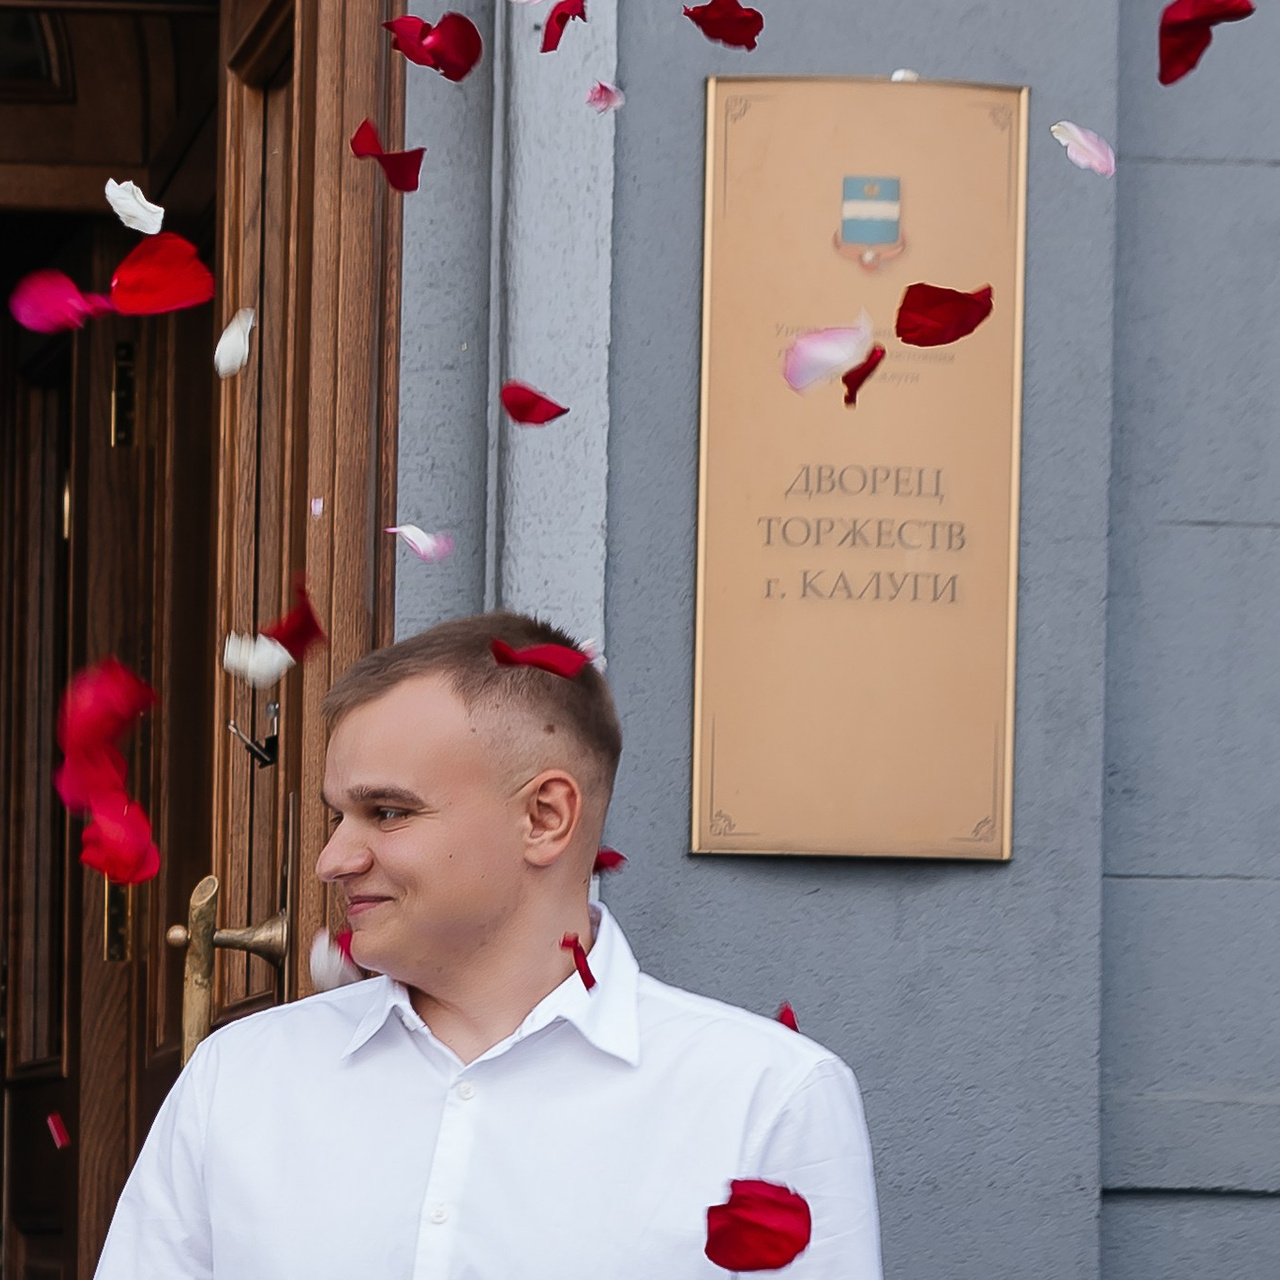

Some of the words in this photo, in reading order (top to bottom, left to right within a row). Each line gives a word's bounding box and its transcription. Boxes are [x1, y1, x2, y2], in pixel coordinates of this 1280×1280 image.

[784, 464, 945, 505] ДВОРЕЦ
[757, 516, 967, 551] ТОРЖЕСТВ
[764, 577, 786, 600] г.
[800, 569, 959, 604] КАЛУГИ
